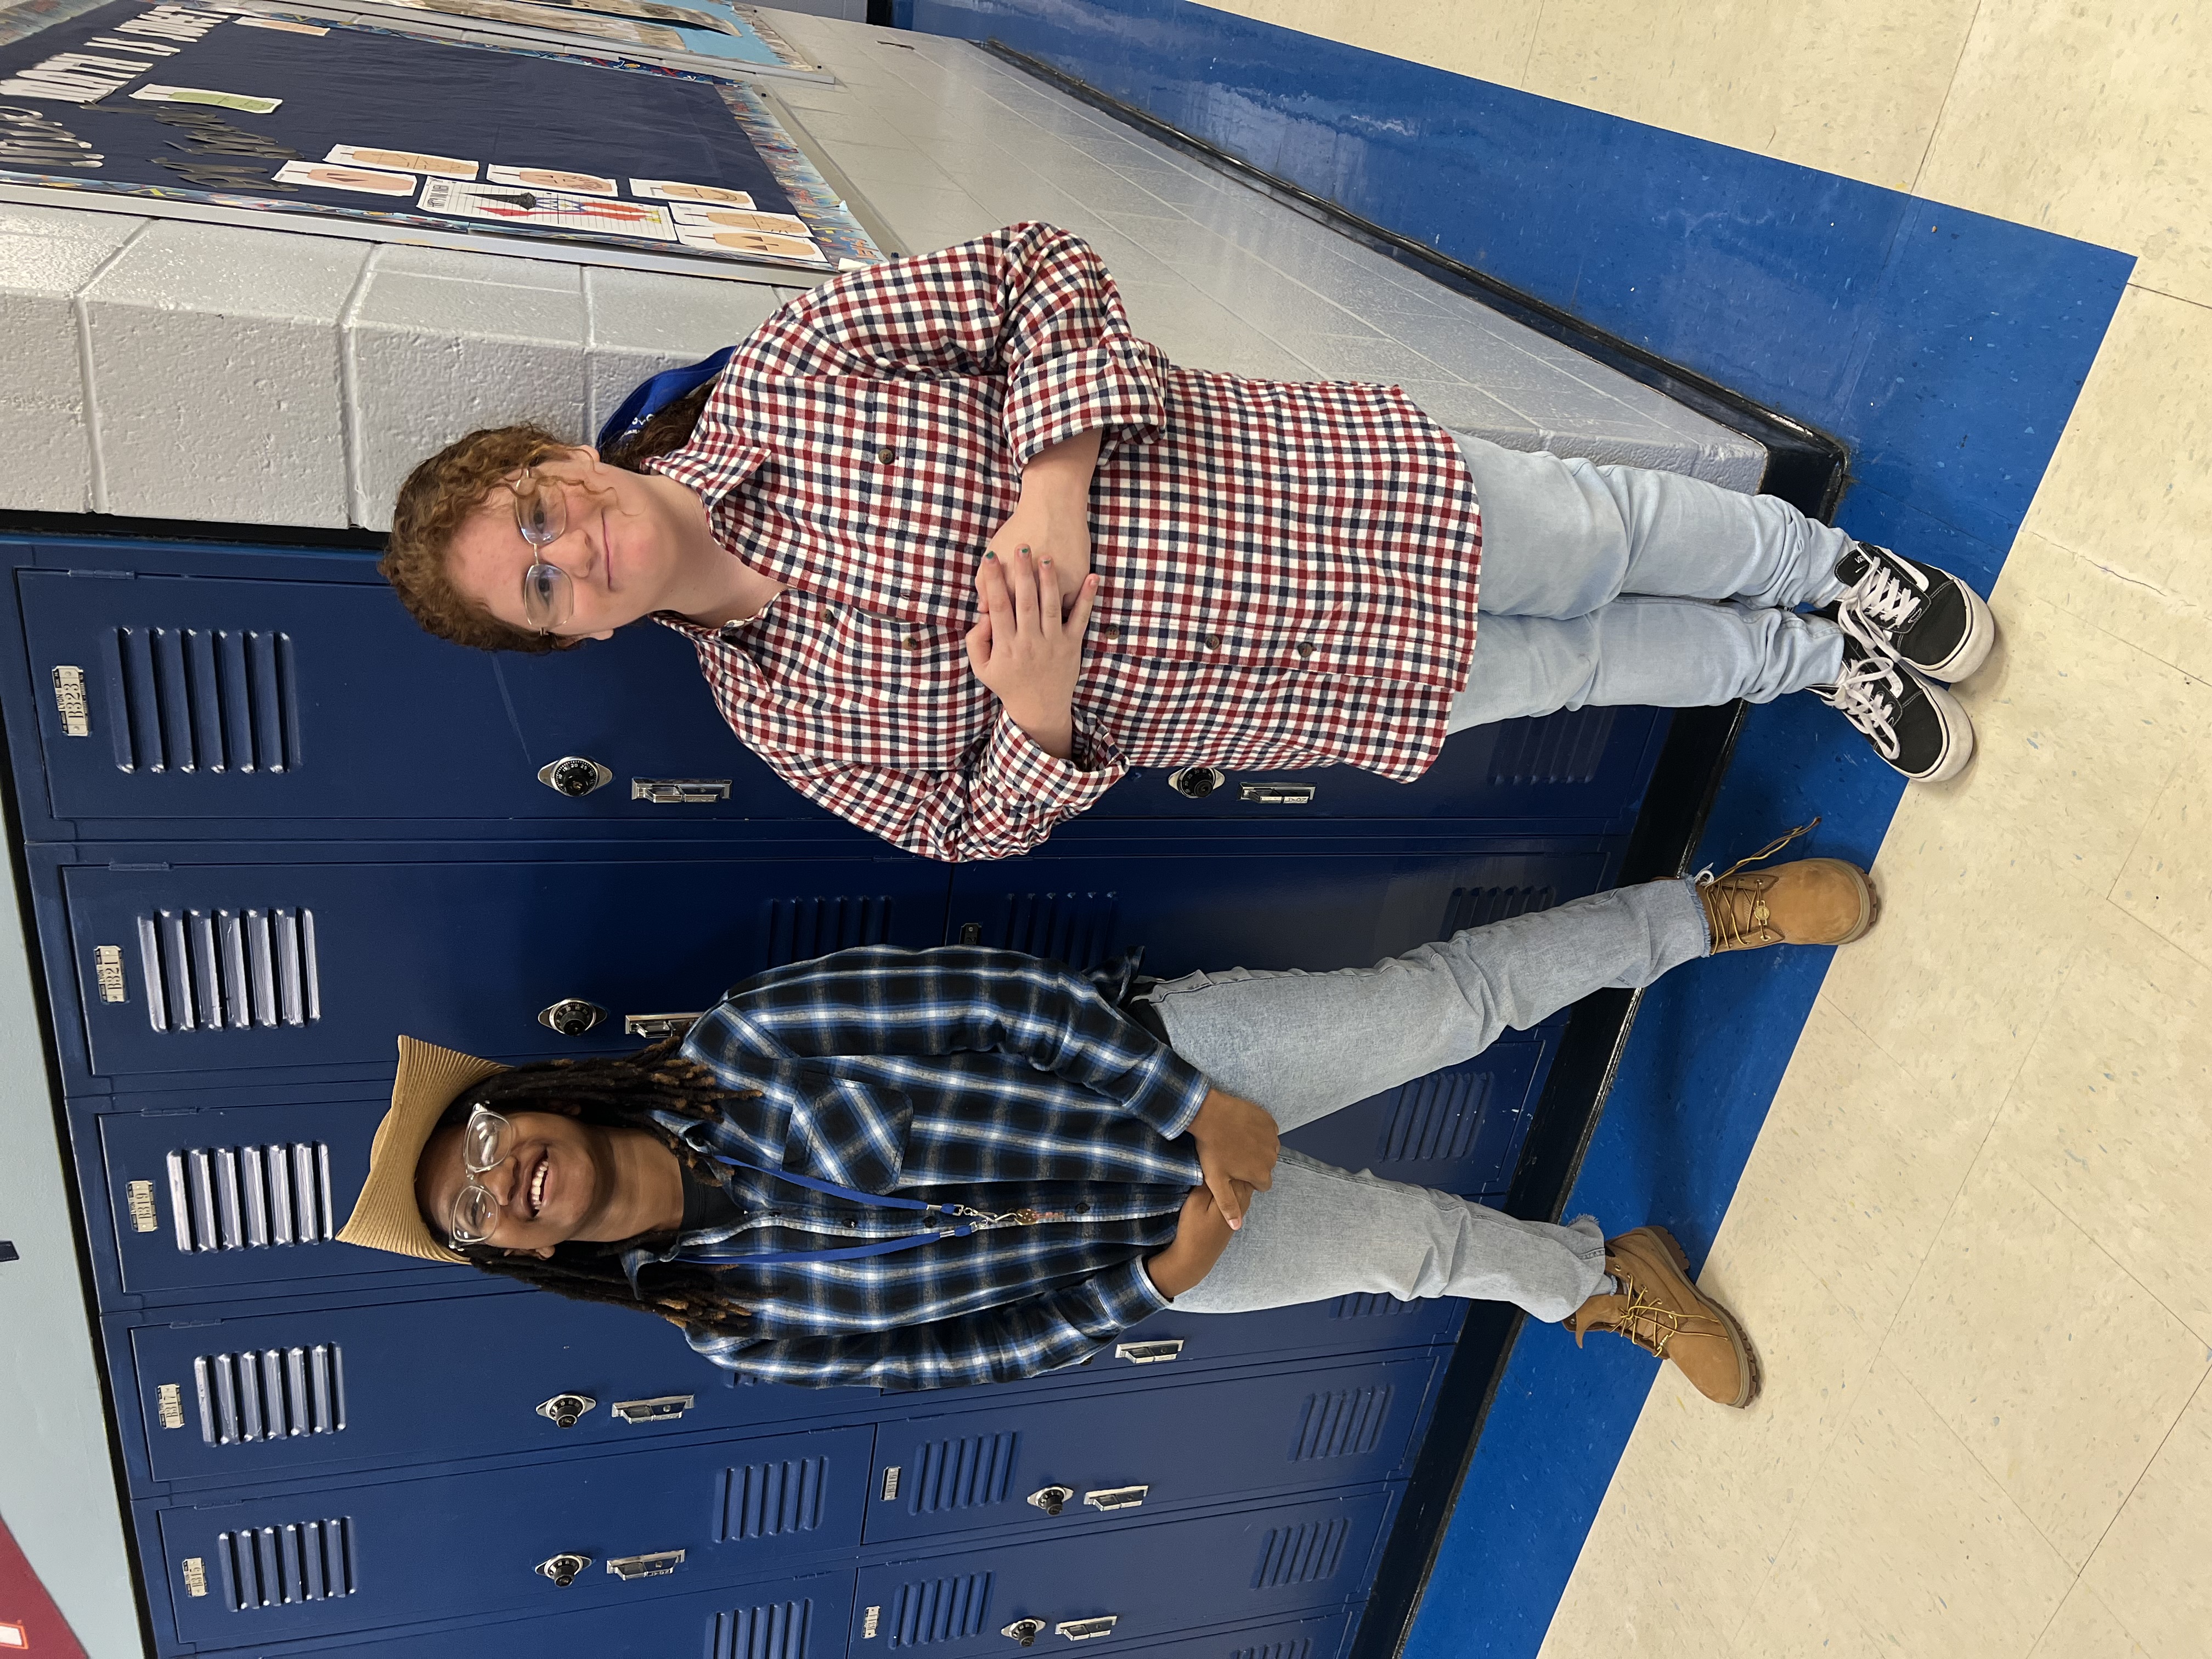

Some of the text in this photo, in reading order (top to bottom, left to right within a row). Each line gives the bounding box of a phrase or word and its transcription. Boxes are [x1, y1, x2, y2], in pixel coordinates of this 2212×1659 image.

[0, 5, 229, 103] MATH IS SWEET
[56, 694, 65, 710] LYON
[63, 683, 84, 718] B323
[104, 962, 122, 990] B321
[135, 1193, 151, 1220] B319
[163, 1395, 178, 1418] B317
[189, 1567, 203, 1588] B315
